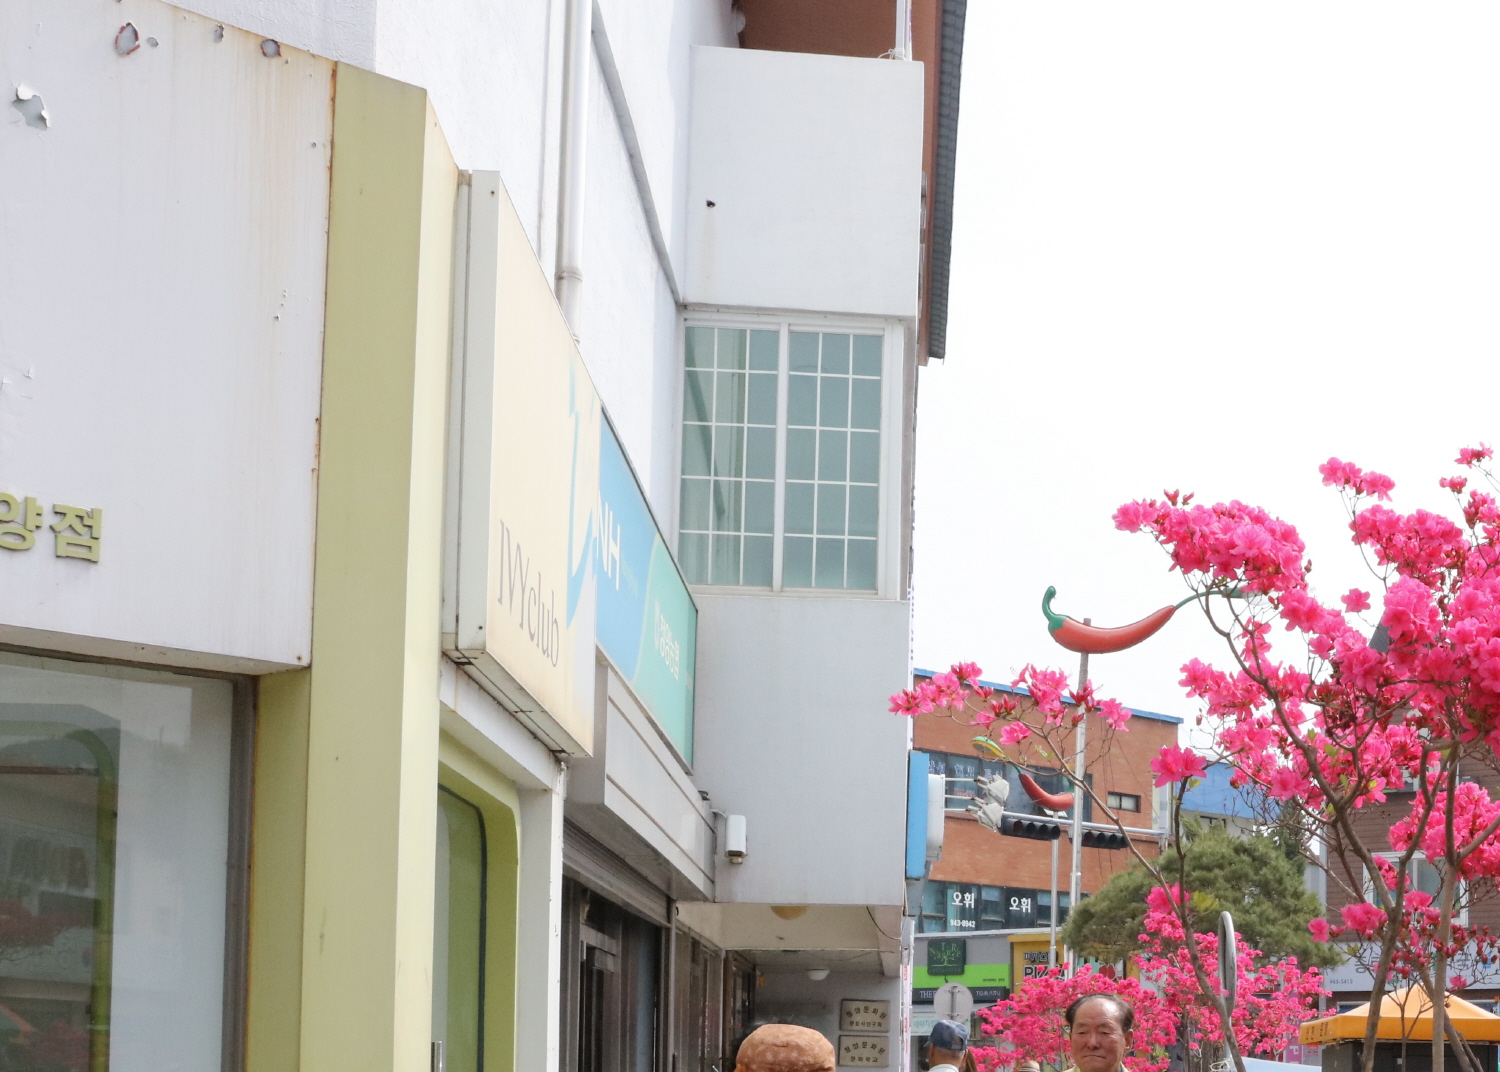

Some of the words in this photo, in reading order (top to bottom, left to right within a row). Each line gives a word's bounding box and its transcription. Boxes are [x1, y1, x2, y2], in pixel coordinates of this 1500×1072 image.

[951, 891, 975, 909] 오휘
[1009, 896, 1032, 913] 오휘
[949, 918, 976, 928] 943-8942
